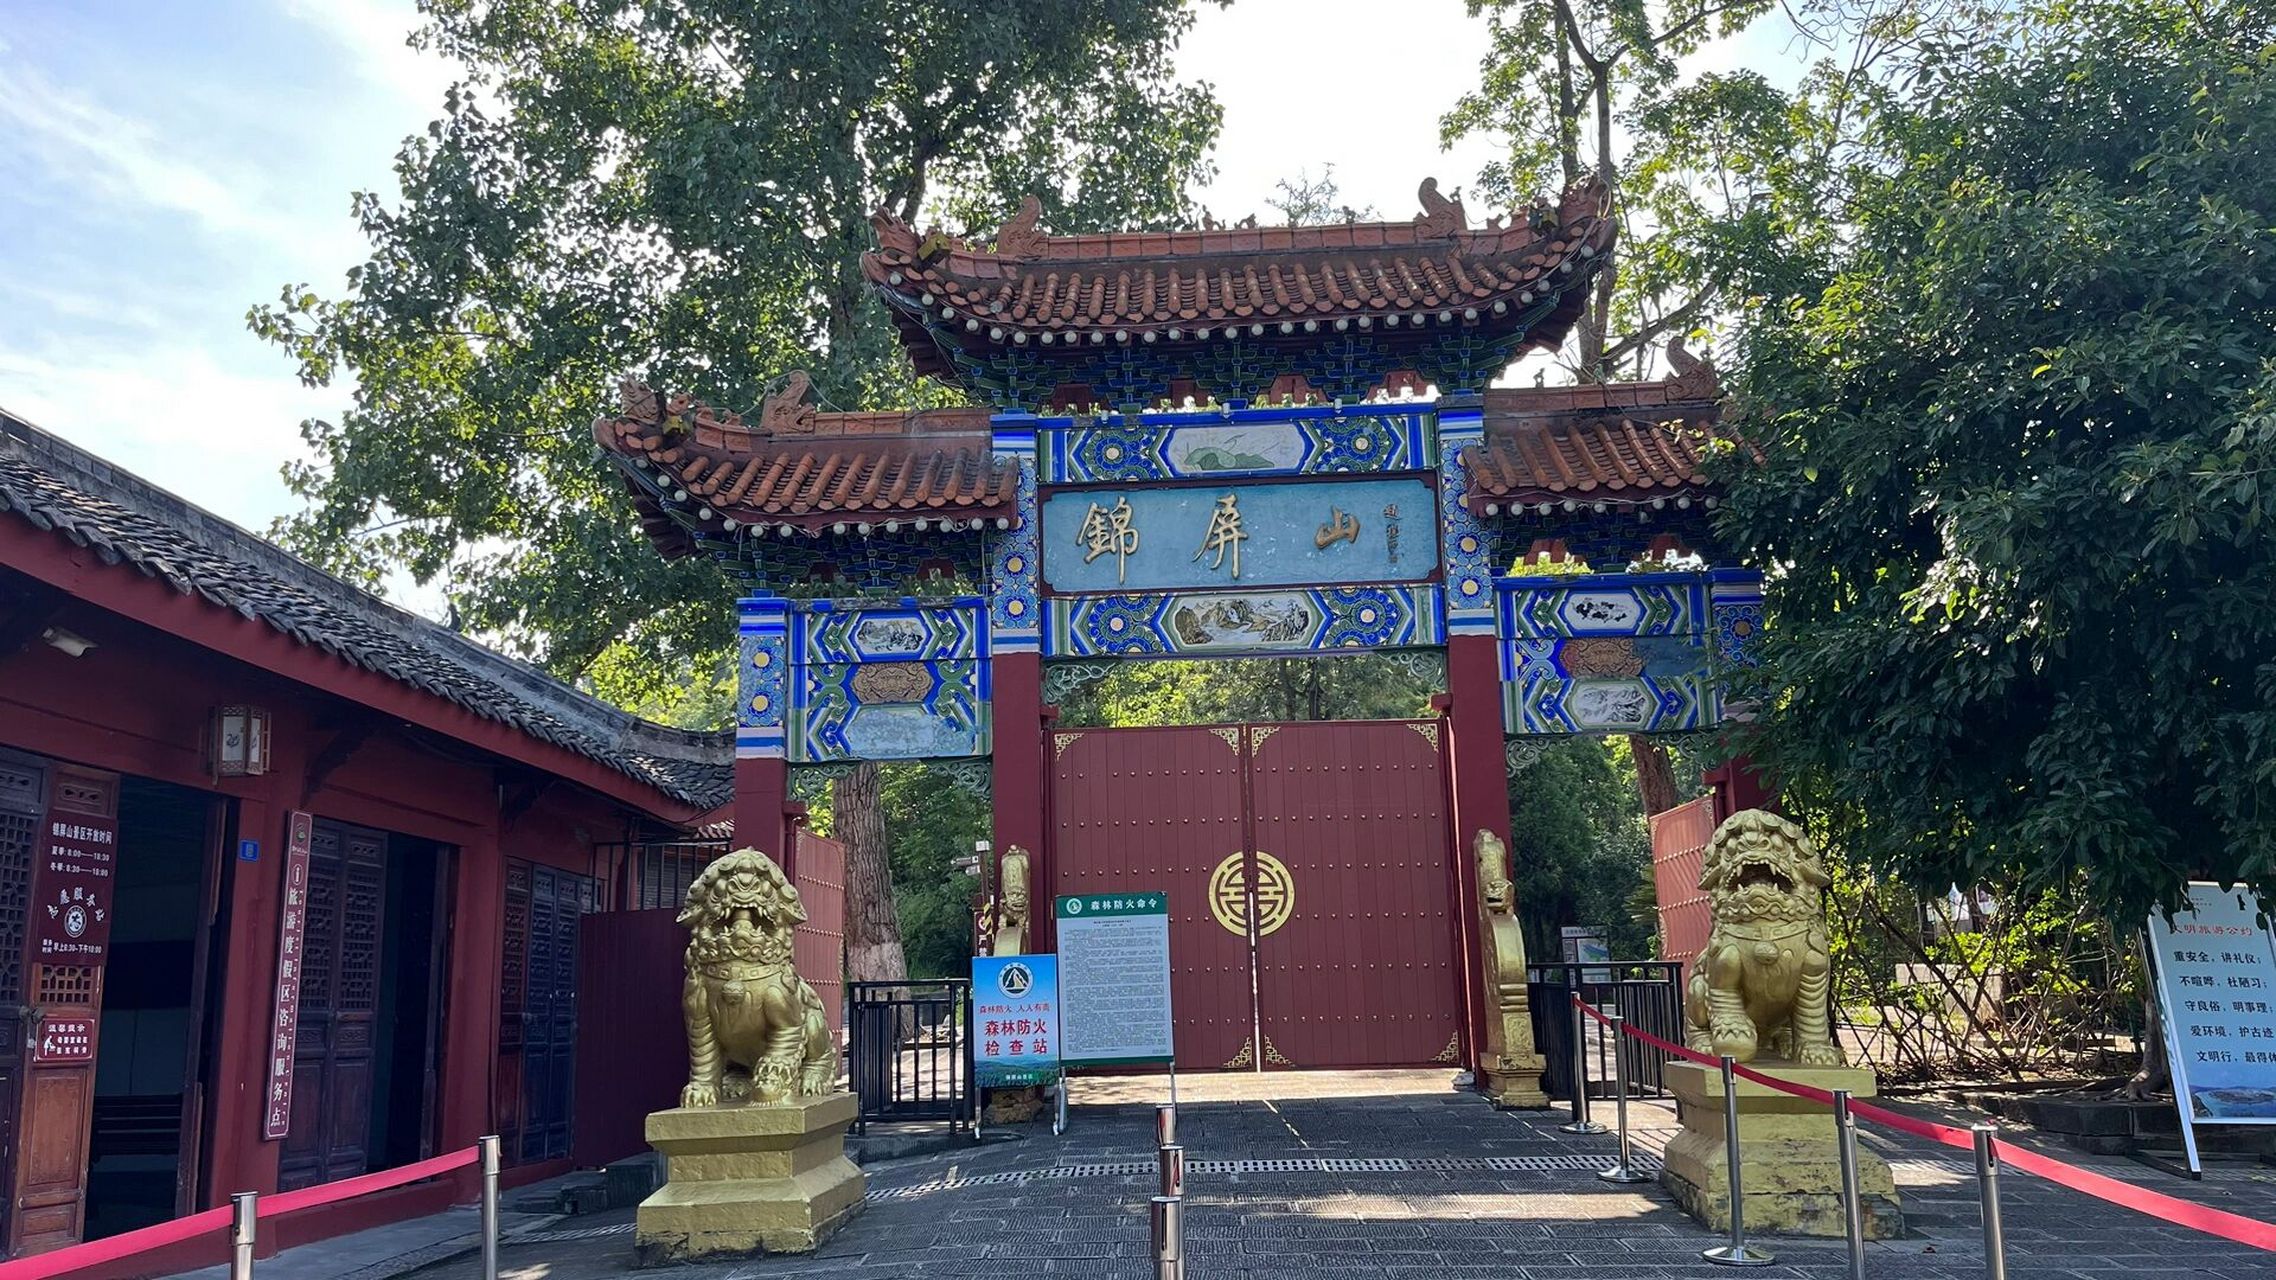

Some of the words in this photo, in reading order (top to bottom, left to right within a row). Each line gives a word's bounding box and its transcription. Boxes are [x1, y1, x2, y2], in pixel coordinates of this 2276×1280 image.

[1091, 898, 1157, 911] 森林防火命令
[2173, 924, 2253, 936] 明旅游公约
[270, 887, 298, 1127] 旅游度假区咨询服务点
[985, 1018, 1047, 1036] 森林防火
[985, 1038, 1048, 1056] 检查站
